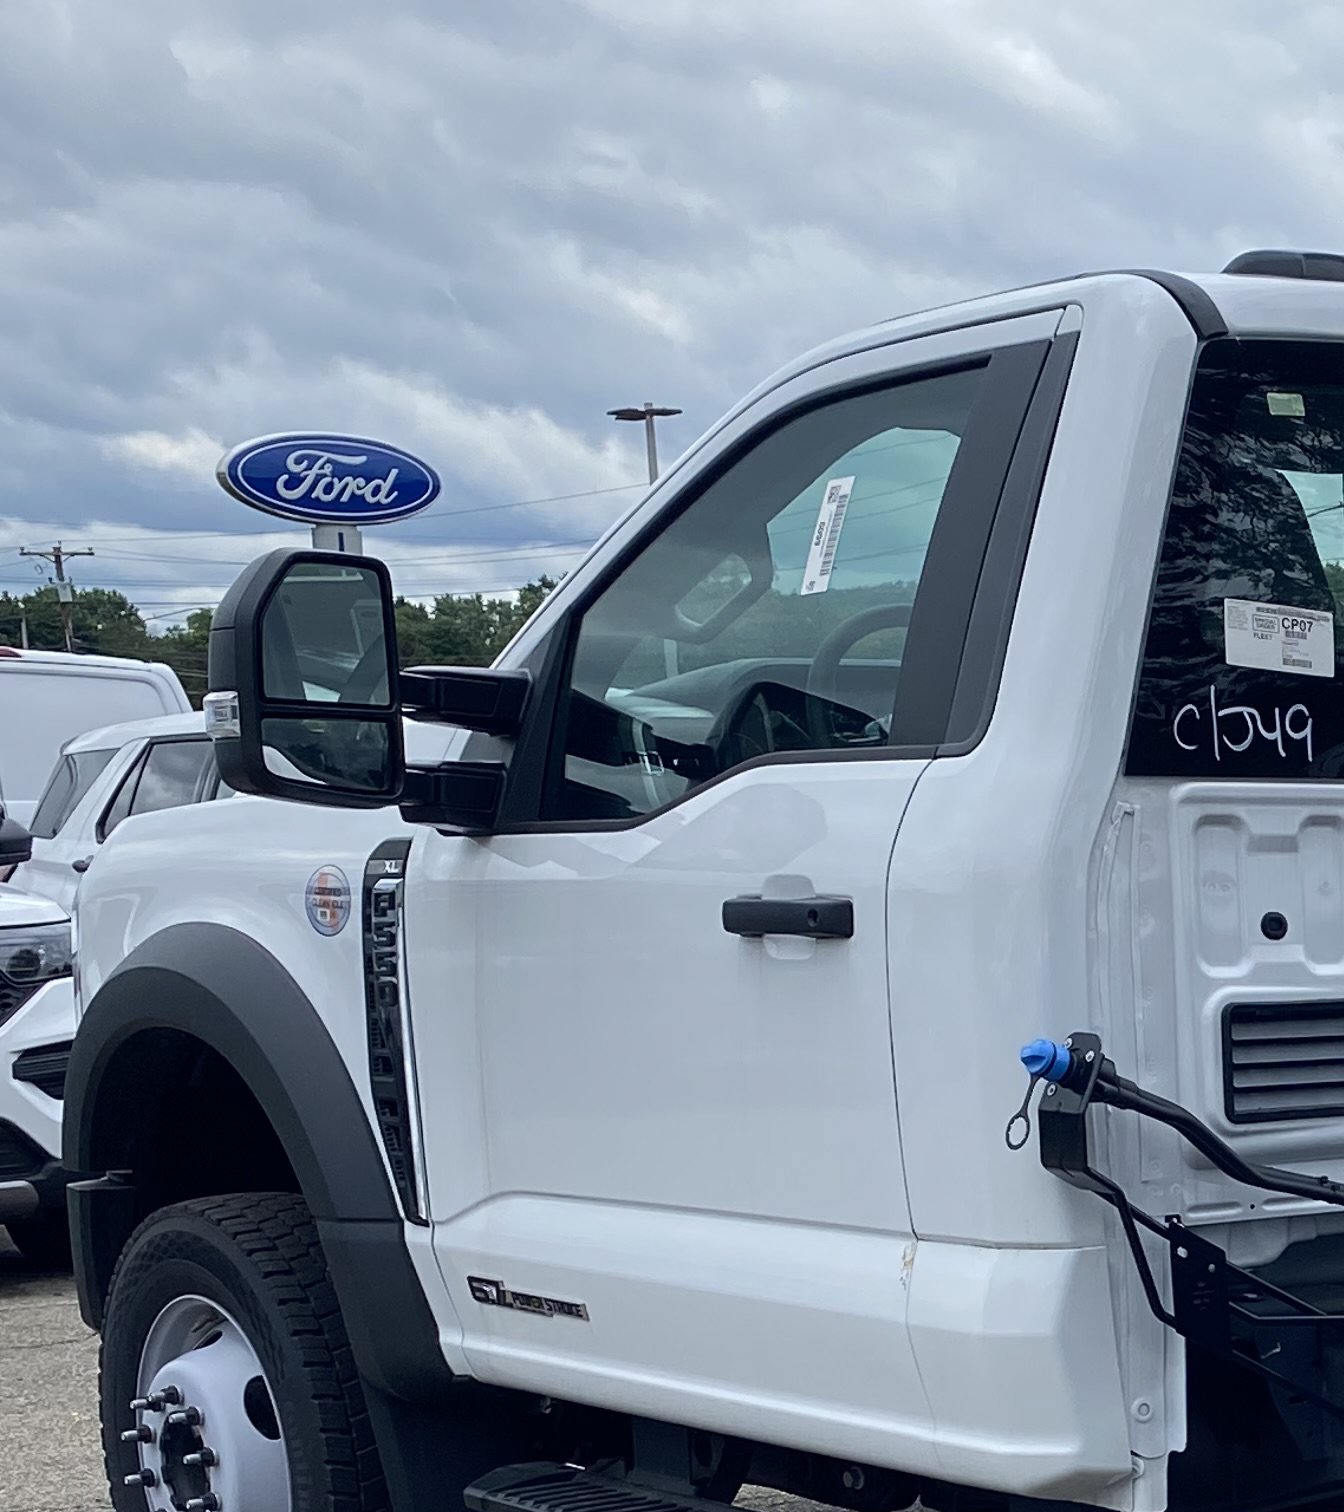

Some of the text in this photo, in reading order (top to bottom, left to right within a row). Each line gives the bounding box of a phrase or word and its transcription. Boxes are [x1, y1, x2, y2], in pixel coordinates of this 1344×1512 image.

[276, 450, 398, 504] Ford
[1281, 617, 1314, 633] CP07
[383, 860, 400, 874] XL
